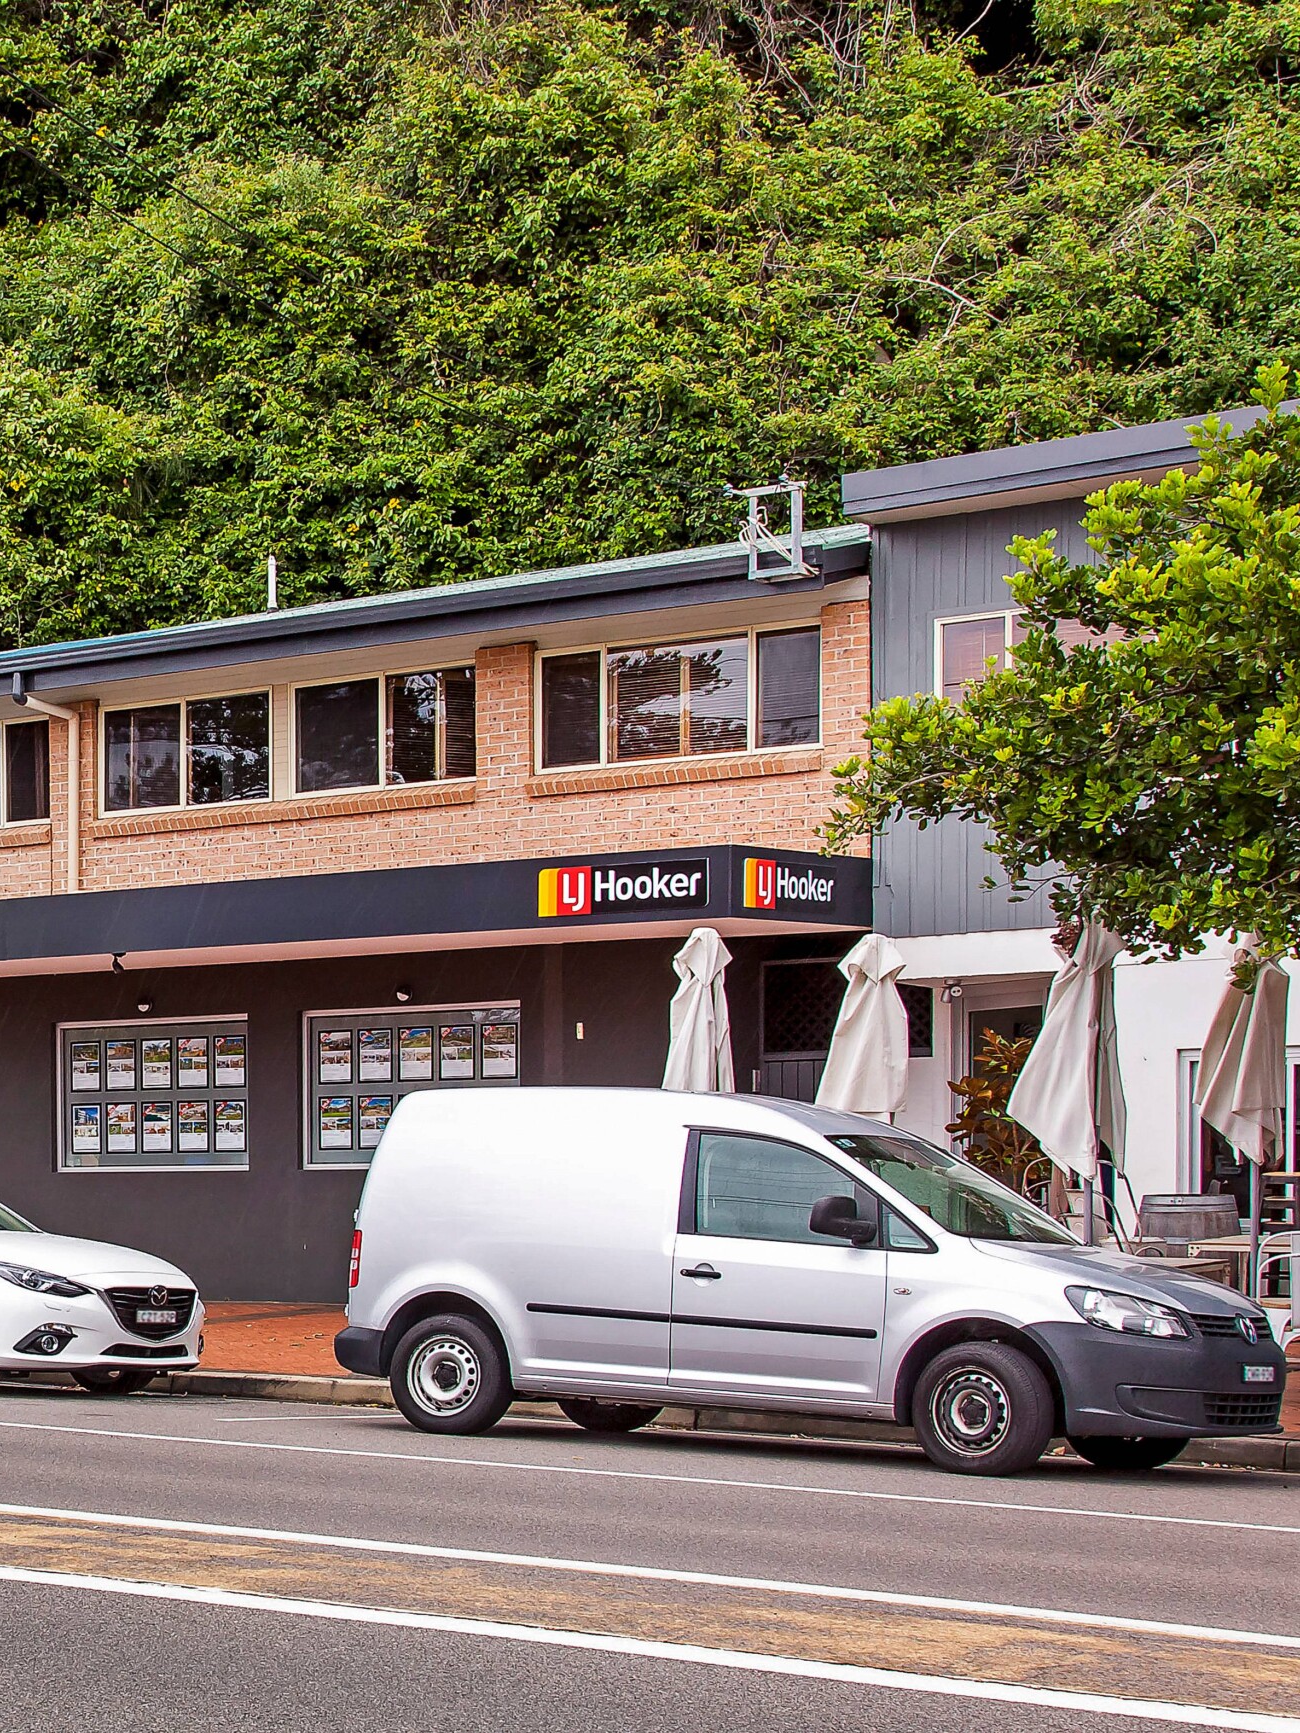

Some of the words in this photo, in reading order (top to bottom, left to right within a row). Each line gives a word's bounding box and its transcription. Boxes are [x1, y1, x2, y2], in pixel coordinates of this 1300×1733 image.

[562, 872, 585, 912] LJ
[594, 867, 701, 902] Hooker
[758, 865, 773, 905] LJ
[776, 867, 834, 902] Hooker
